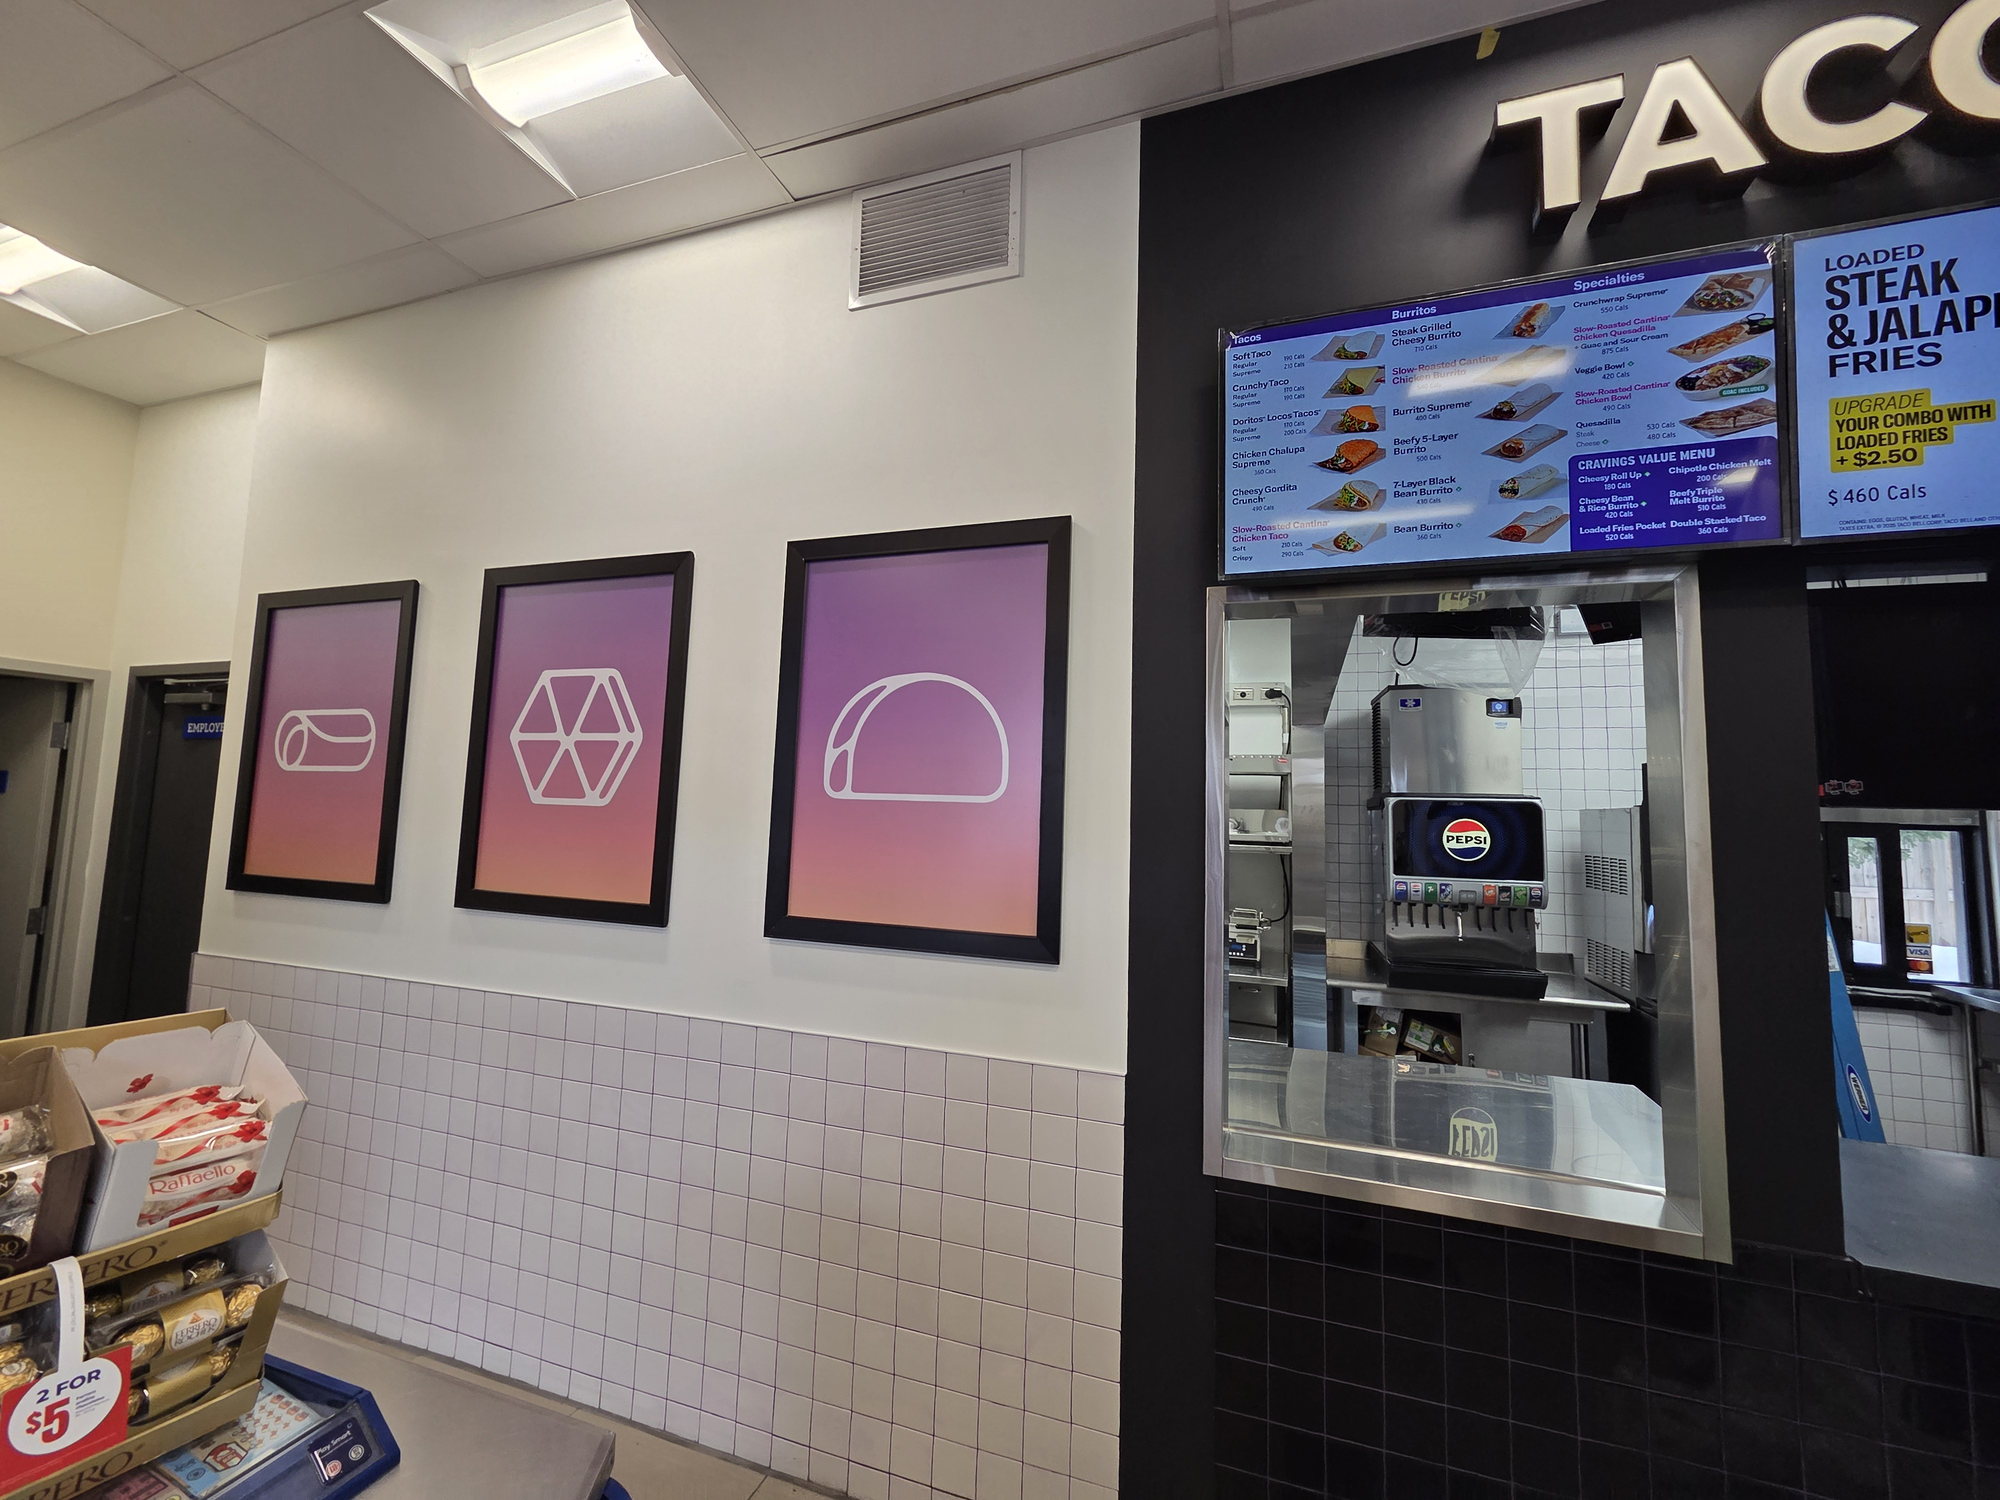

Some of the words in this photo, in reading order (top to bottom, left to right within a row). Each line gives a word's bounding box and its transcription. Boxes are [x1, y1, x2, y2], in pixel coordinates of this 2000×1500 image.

[1825, 244, 1924, 272] LOADED
[1574, 272, 1645, 291] Specialties
[1825, 258, 1960, 310] STEAK
[1573, 296, 1625, 308] Crunchwrap
[1392, 306, 1437, 319] Burritos
[1600, 306, 1613, 314] 550
[1615, 304, 1629, 312] Cals
[1573, 320, 1631, 334] Slow-Roasted
[1826, 314, 1857, 349] &
[1863, 293, 2000, 346] JALAP
[1392, 327, 1418, 337] Steak
[1420, 321, 1452, 333] Grilled
[1573, 332, 1608, 342] Chicken
[1610, 325, 1656, 337] Quesadilla
[1233, 334, 1262, 345] Tacos
[1392, 336, 1426, 346] Cheesy
[1428, 331, 1461, 341] Burrito
[1580, 341, 1602, 350] Guac
[1641, 333, 1669, 341] Cream
[1233, 352, 1250, 361] Soft
[1250, 350, 1272, 359] Taco
[1829, 342, 1943, 378] FRIES
[1233, 361, 1257, 369] Regular
[1392, 360, 1457, 375] Slow-Roasted
[1575, 365, 1602, 375] Veggie
[1604, 362, 1625, 371] Bowl
[1233, 369, 1261, 377] Supreme
[1392, 374, 1432, 384] Chicken
[1433, 369, 1466, 379] Burrito
[1233, 381, 1268, 392] Crunchy
[1269, 379, 1289, 387] Taco
[1575, 385, 1632, 398] Slow-Roasted
[1233, 393, 1257, 401] Regular
[1575, 397, 1609, 406] Chicken
[1611, 393, 1632, 402] Bowl
[1233, 400, 1261, 408] Supreme
[1602, 404, 1616, 412] 490
[1834, 392, 1925, 416] UPGRADE
[1267, 413, 1293, 422] Locos
[1392, 406, 1425, 416] Burrito
[1576, 418, 1621, 429] Quesadilla
[1835, 416, 1879, 433] YOUR
[1883, 409, 1943, 428] COMBO
[1947, 403, 1991, 422] WITH
[1233, 427, 1257, 435] Regular
[1233, 435, 1261, 443] Supreme
[1393, 436, 1421, 446] Beefy
[1422, 433, 1459, 443] 5-Layer
[1576, 440, 1601, 448] Cheese
[1836, 432, 1899, 451] LOADED
[1902, 426, 1948, 444] FRIES
[1233, 450, 1267, 460] Chicken
[1268, 446, 1305, 456] Chalupa
[1393, 445, 1426, 455] Burrito
[1578, 456, 1636, 470] CRAVINGS
[1638, 452, 1677, 464] VALUE
[1680, 448, 1716, 460] MENU
[1853, 448, 1918, 467] $2.50
[1232, 460, 1271, 469] Supreme
[1668, 464, 1708, 474] Chipotle
[1708, 461, 1748, 471] Chicken
[1749, 458, 1772, 467] Melt
[1393, 479, 1427, 489] 7-Layer
[1428, 476, 1456, 486] Black
[1578, 475, 1610, 483] Cheesy
[1611, 472, 1628, 480] Roll
[1629, 471, 1642, 479] Up
[1232, 488, 1264, 497] Cheesy
[1264, 483, 1298, 493] Gordita
[1393, 490, 1417, 499] Bean
[1419, 486, 1453, 496] Burrito
[1669, 489, 1696, 498] Beefy
[1696, 487, 1723, 496] Triple
[1843, 487, 1880, 503] 460
[1887, 484, 1927, 500] Cals
[1579, 497, 1610, 505] Cheesy
[1611, 495, 1634, 503] Bean
[1587, 504, 1607, 512] Rice
[1608, 501, 1639, 510] Burrito
[1669, 497, 1691, 505] Melt
[1692, 495, 1725, 504] Burrito
[1393, 525, 1417, 533] Bean
[1420, 522, 1453, 532] Burrito
[1579, 525, 1611, 534] Loaded
[1612, 524, 1634, 532] Fries
[1635, 521, 1667, 530] Pocket
[1670, 519, 1703, 528] Double
[1704, 515, 1743, 525] Stacked
[1743, 514, 1767, 522] Taco
[1232, 522, 1291, 534] Slow-Roasted
[1232, 534, 1267, 543] Chicken
[1268, 532, 1289, 541] Taco
[1619, 532, 1634, 540] Cals
[1232, 555, 1253, 563] Crispy
[1446, 835, 1487, 845] PEPSI
[1908, 948, 1930, 956] VISA
[149, 1165, 235, 1194] Raffaello
[36, 1389, 50, 1404] 2
[56, 1369, 101, 1396] FOR
[25, 1396, 71, 1443] $5
[331, 1430, 351, 1446] Smart
